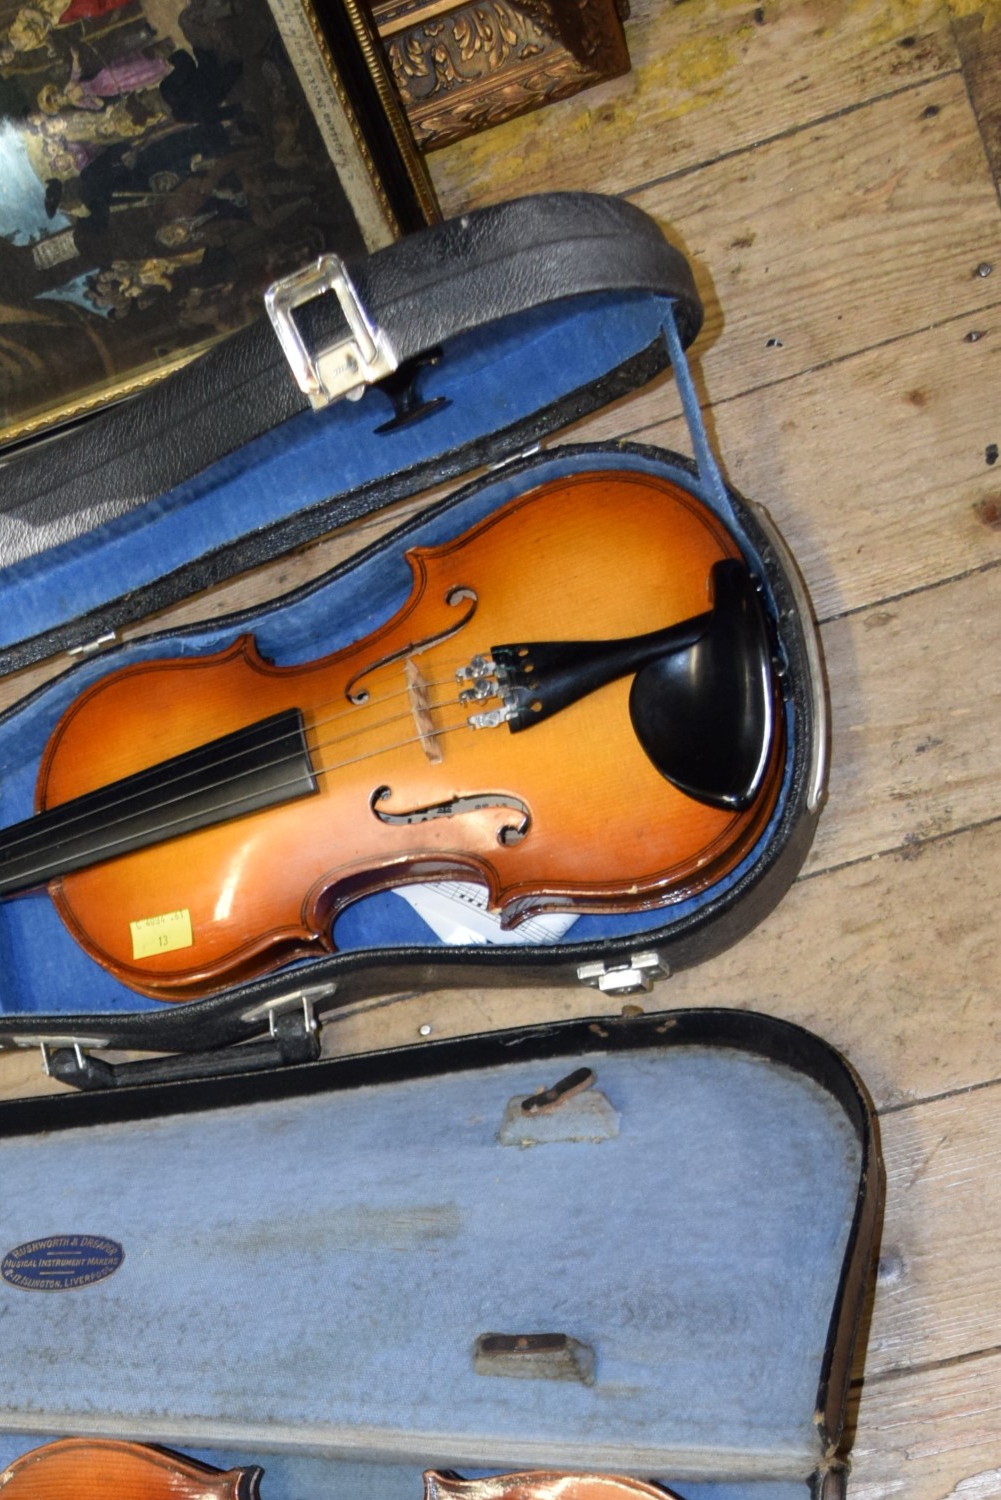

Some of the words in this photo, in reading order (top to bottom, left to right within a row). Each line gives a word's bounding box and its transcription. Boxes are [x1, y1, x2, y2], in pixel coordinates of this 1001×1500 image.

[158, 935, 169, 947] 13
[12, 1237, 69, 1259] RUSHWORTH
[71, 1238, 79, 1246] &
[4, 1259, 36, 1268] MUSICAL
[38, 1258, 85, 1268] INSTRUMENT
[86, 1256, 118, 1266] MAKERS
[64, 1266, 113, 1287] LIVERPOOL
